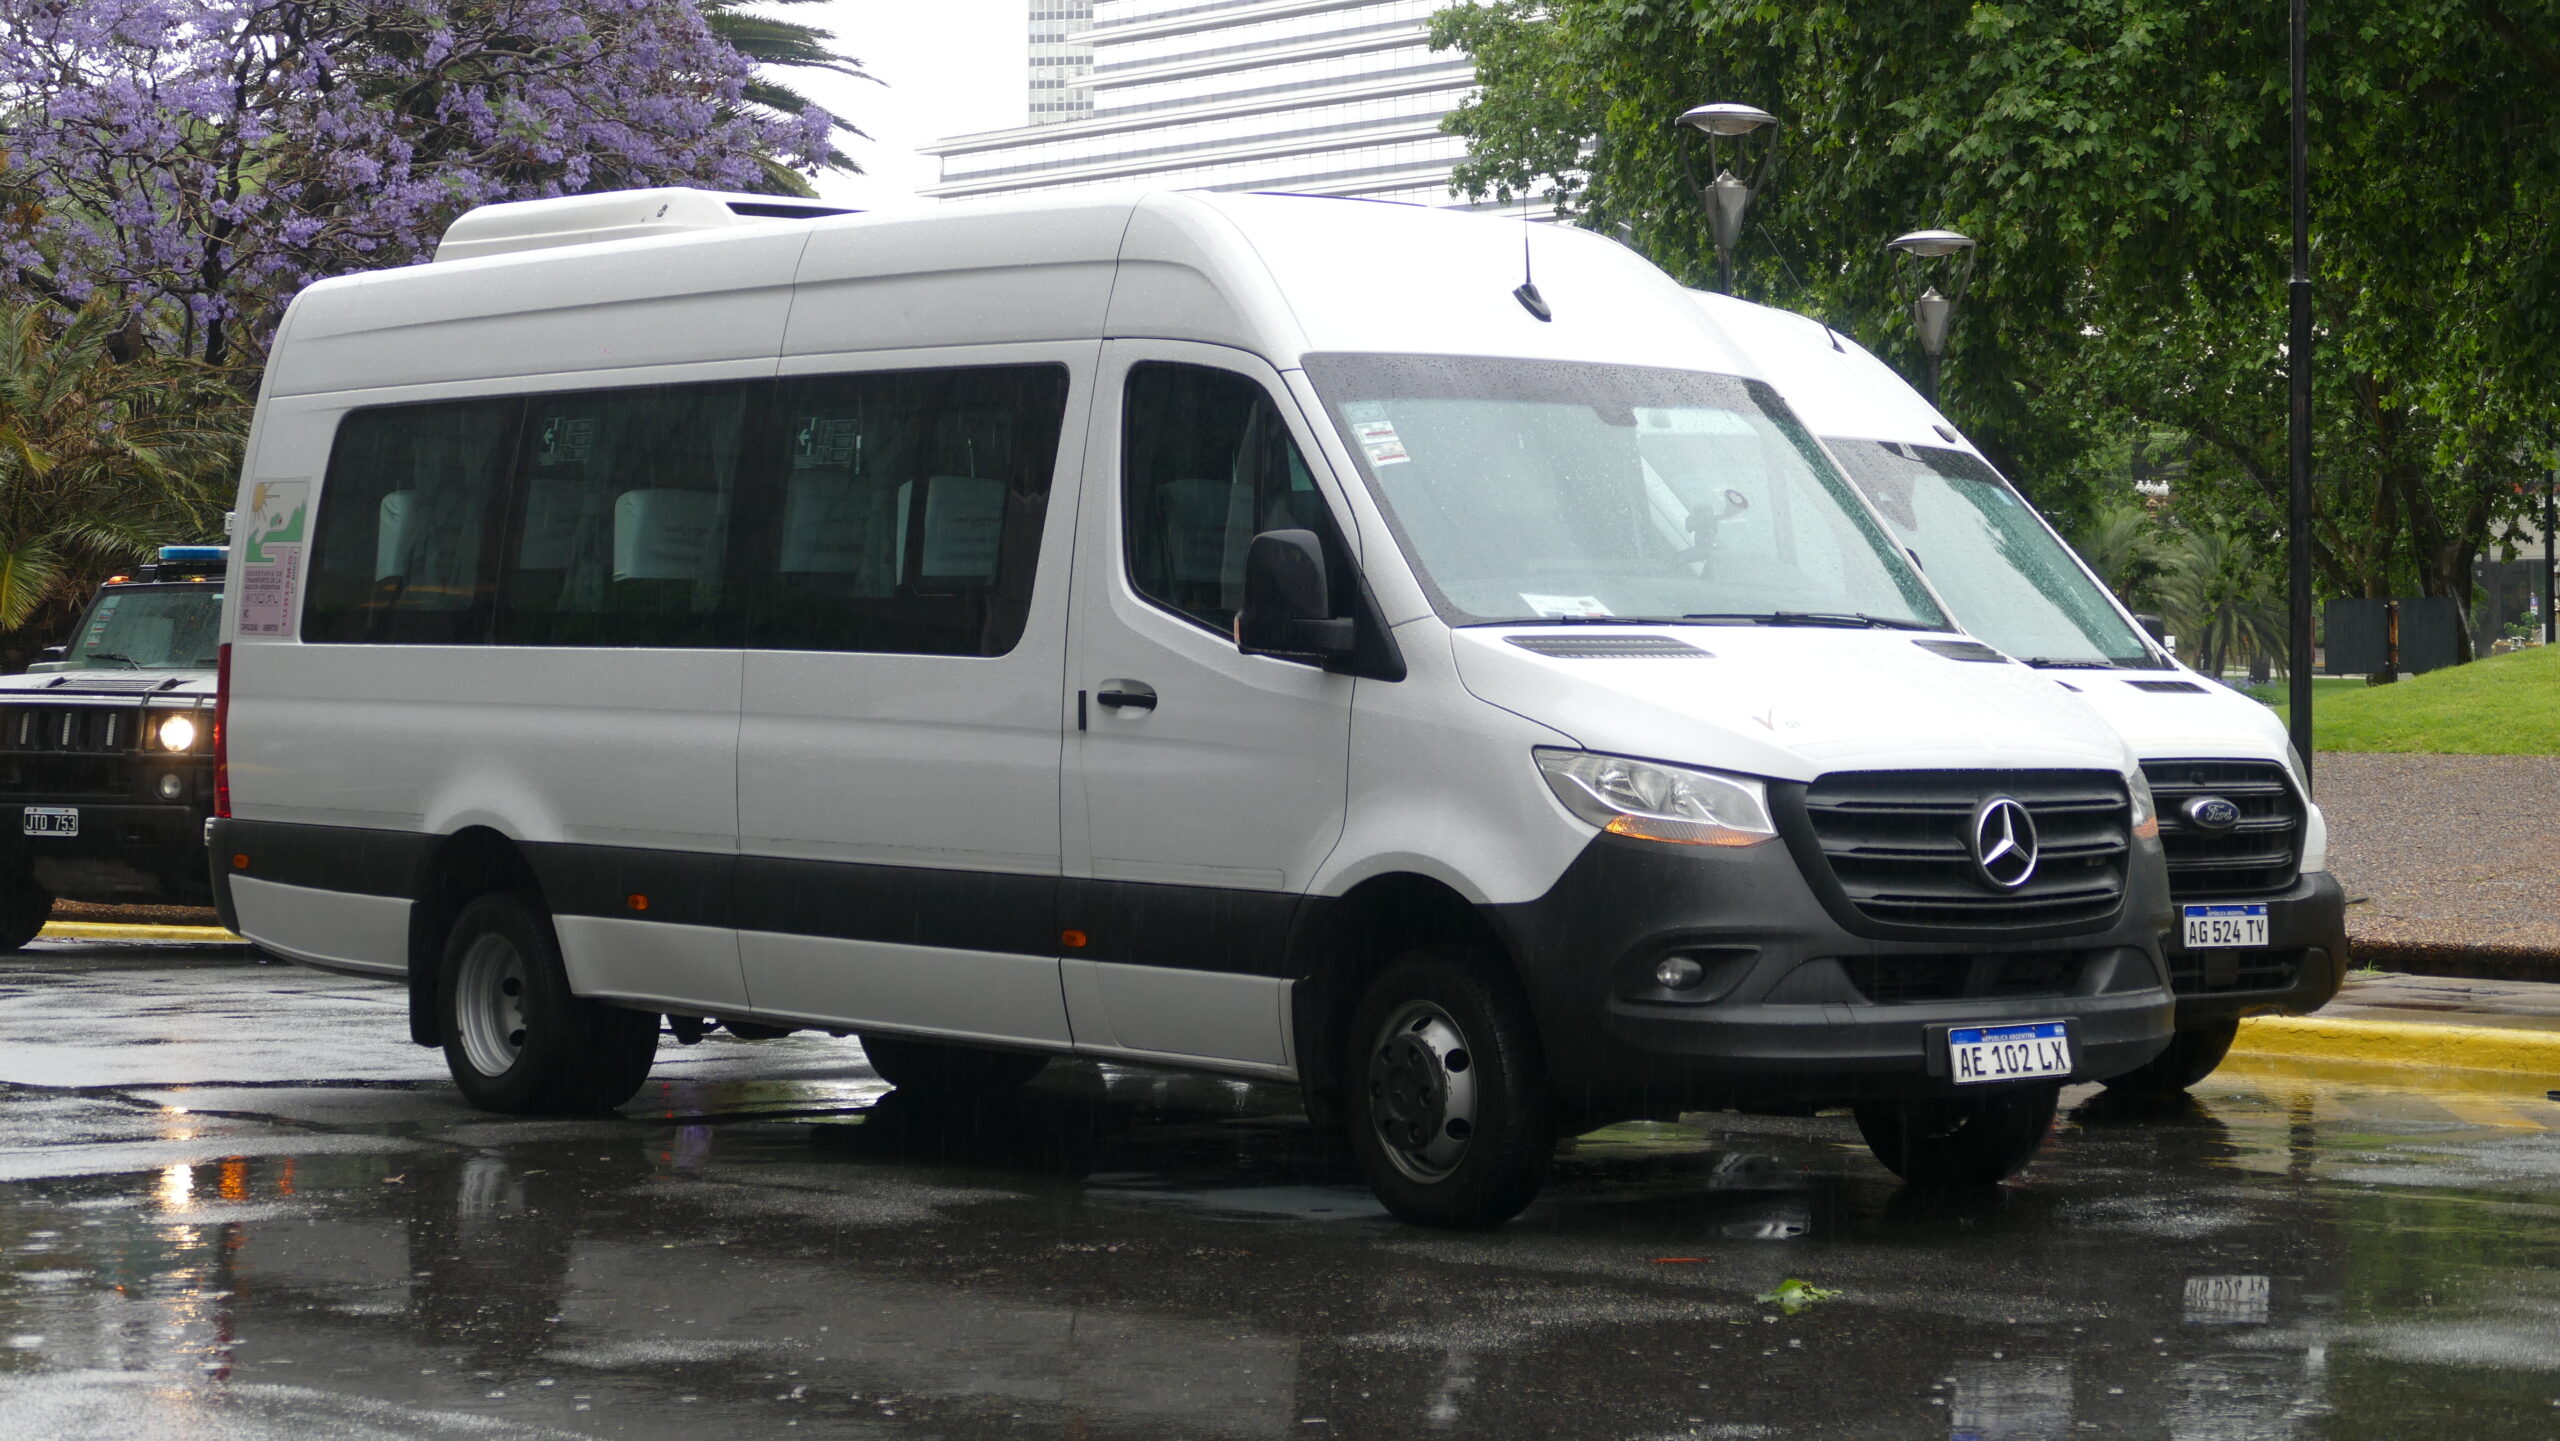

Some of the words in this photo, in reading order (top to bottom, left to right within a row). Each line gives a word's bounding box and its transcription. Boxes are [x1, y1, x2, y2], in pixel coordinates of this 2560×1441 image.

[54, 815, 76, 831] 753
[2206, 804, 2233, 821] Ford
[2189, 920, 2208, 944] AG
[2213, 920, 2241, 943] 524
[2246, 919, 2265, 942] TY
[1961, 1046, 1987, 1077] AE
[1992, 1043, 2033, 1074] 102
[2037, 1040, 2066, 1071] LX
